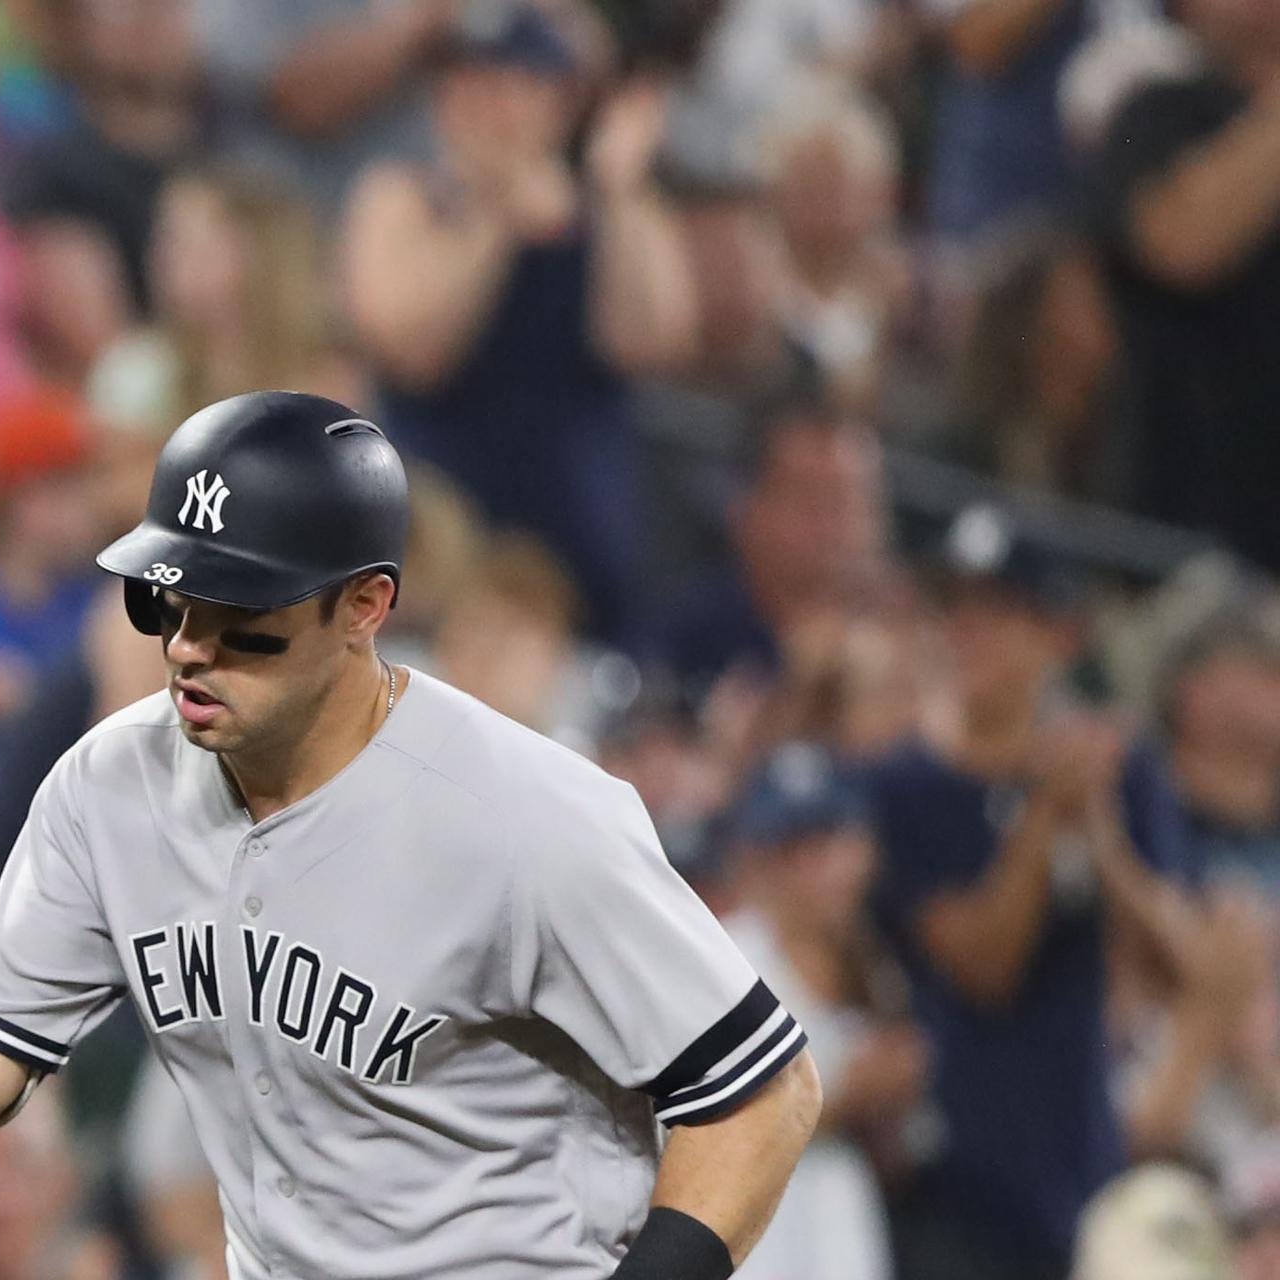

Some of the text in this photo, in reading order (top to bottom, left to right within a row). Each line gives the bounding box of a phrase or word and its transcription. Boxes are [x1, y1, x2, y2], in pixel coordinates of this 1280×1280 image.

[178, 469, 231, 533] NY
[143, 563, 183, 585] 39
[129, 920, 449, 1085] EW YORK
